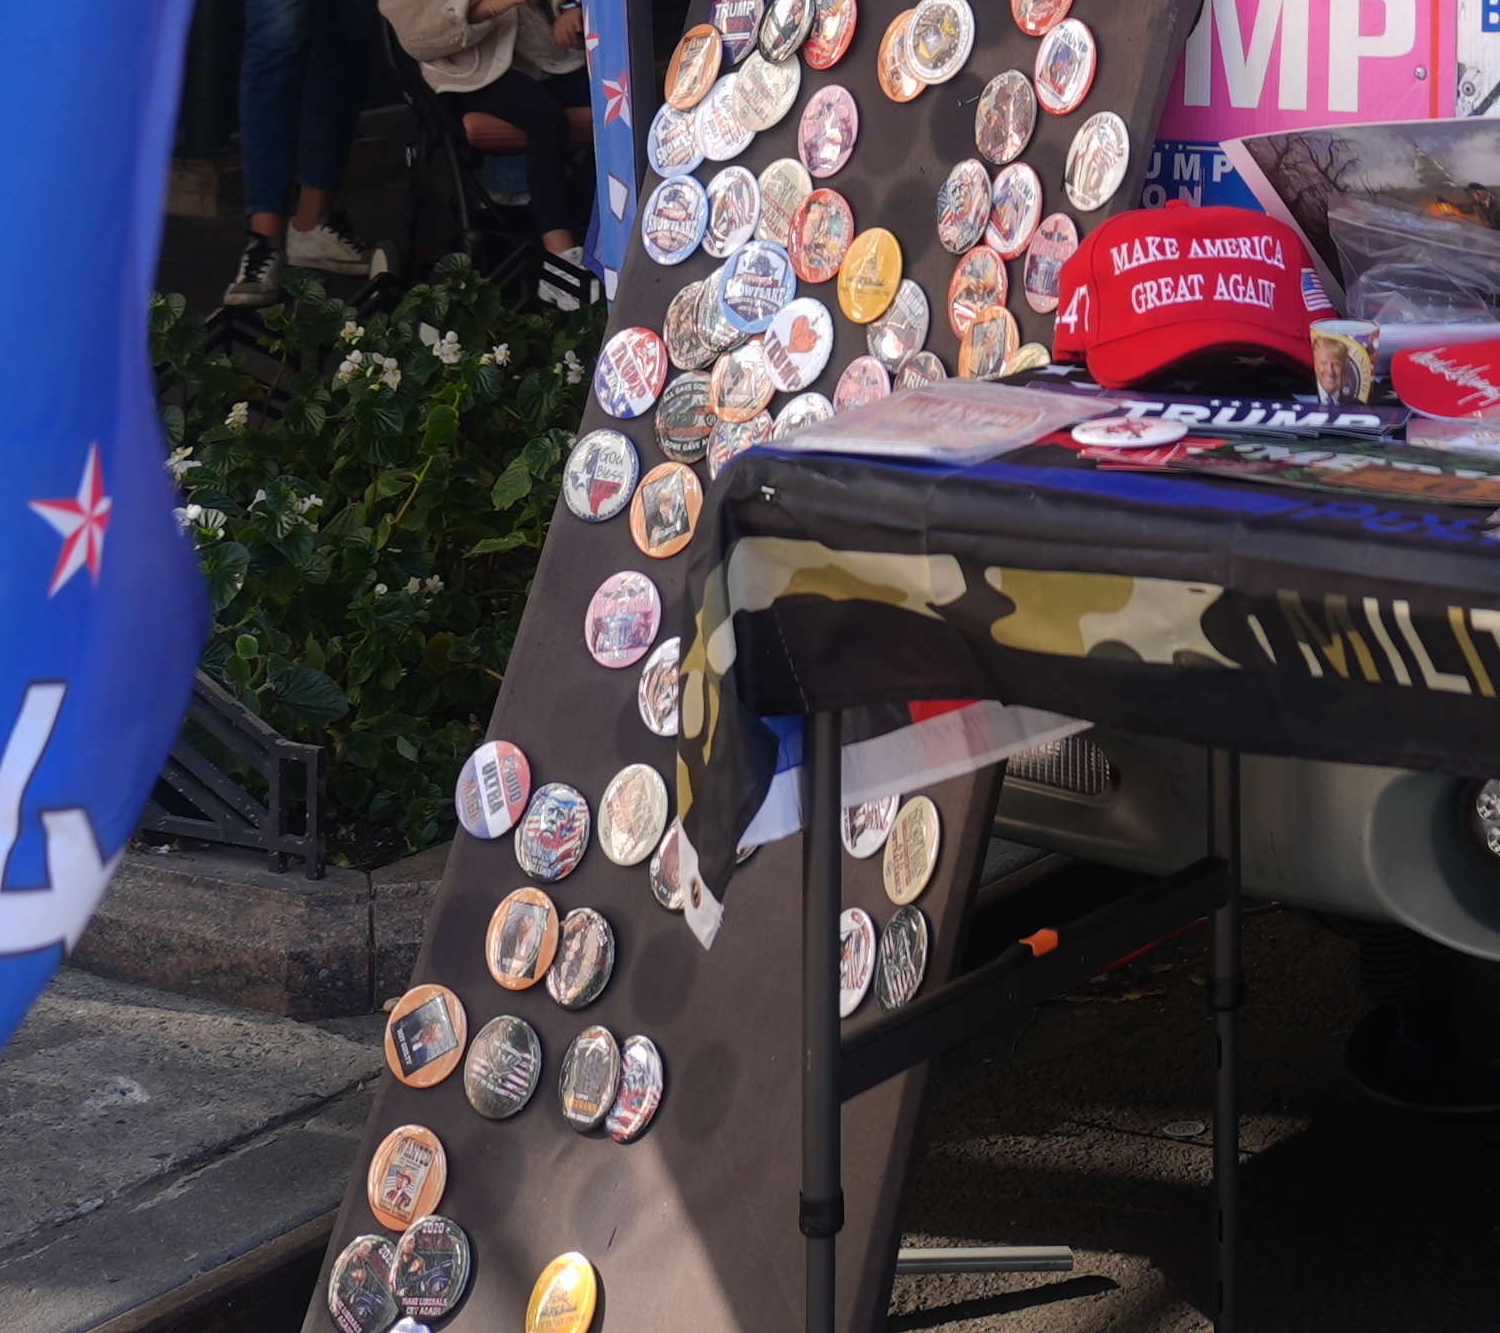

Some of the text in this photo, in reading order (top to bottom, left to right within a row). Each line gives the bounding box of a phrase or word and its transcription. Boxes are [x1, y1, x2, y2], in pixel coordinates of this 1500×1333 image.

[1110, 237, 1180, 275] MAKE
[1188, 235, 1285, 270] AMERICA
[1132, 273, 1276, 314] GREAT AGAIN
[481, 759, 505, 817] ULTRA
[502, 754, 524, 805] PROUD
